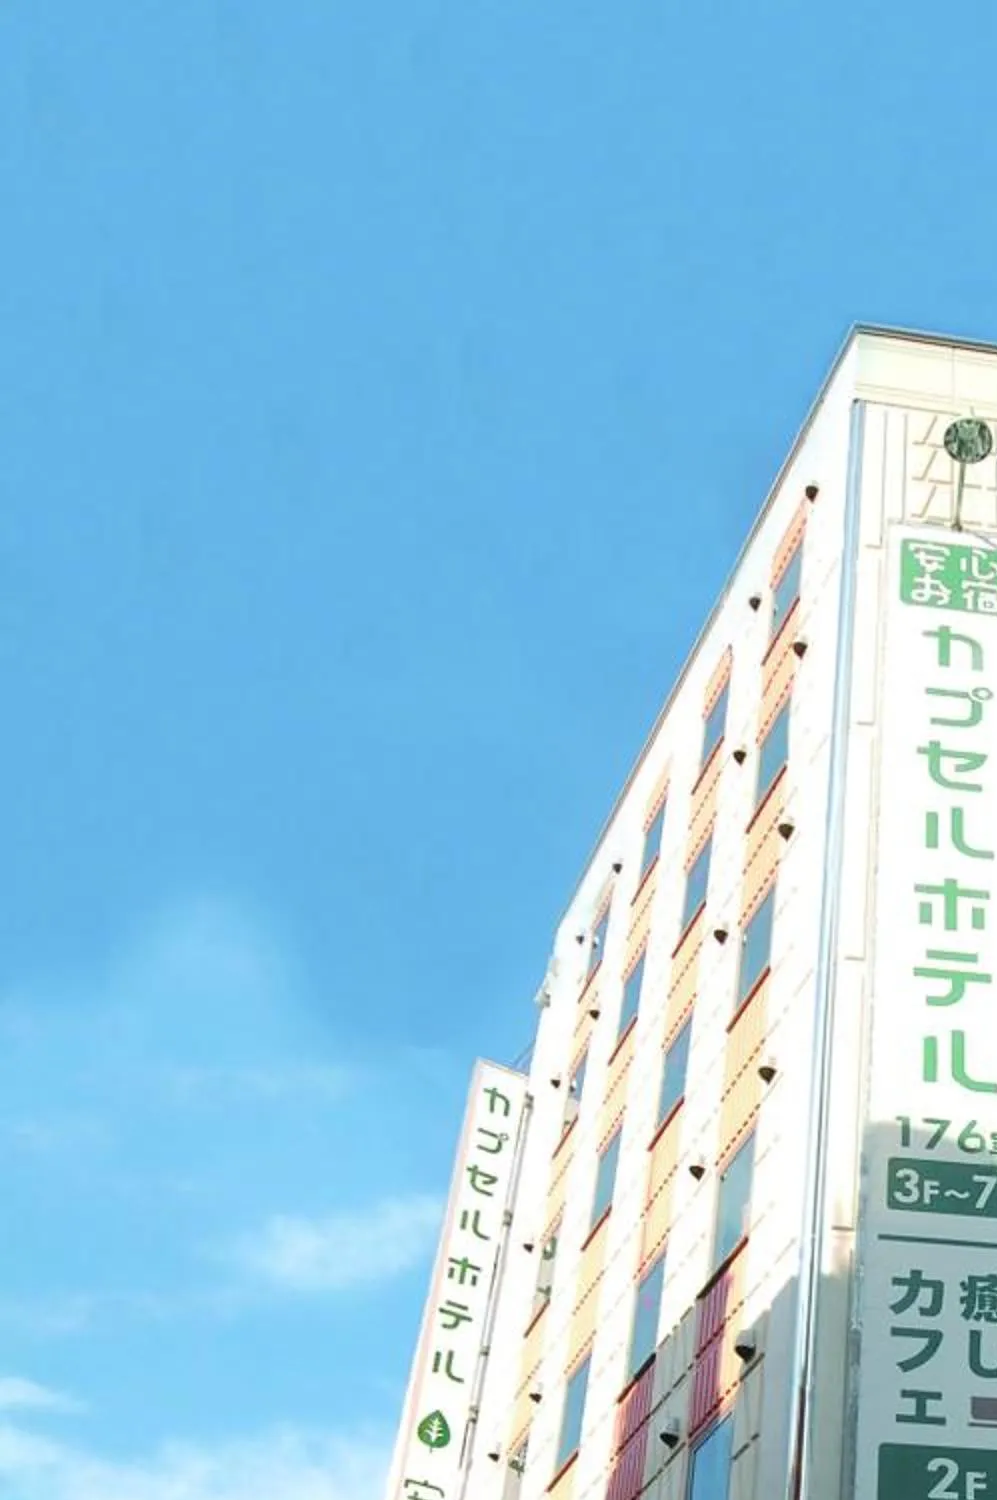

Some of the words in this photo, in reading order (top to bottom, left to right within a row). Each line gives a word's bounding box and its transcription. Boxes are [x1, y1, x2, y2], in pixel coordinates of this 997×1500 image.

[432, 1086, 511, 1384] カプセルホテル
[888, 1269, 947, 1427] カフェ
